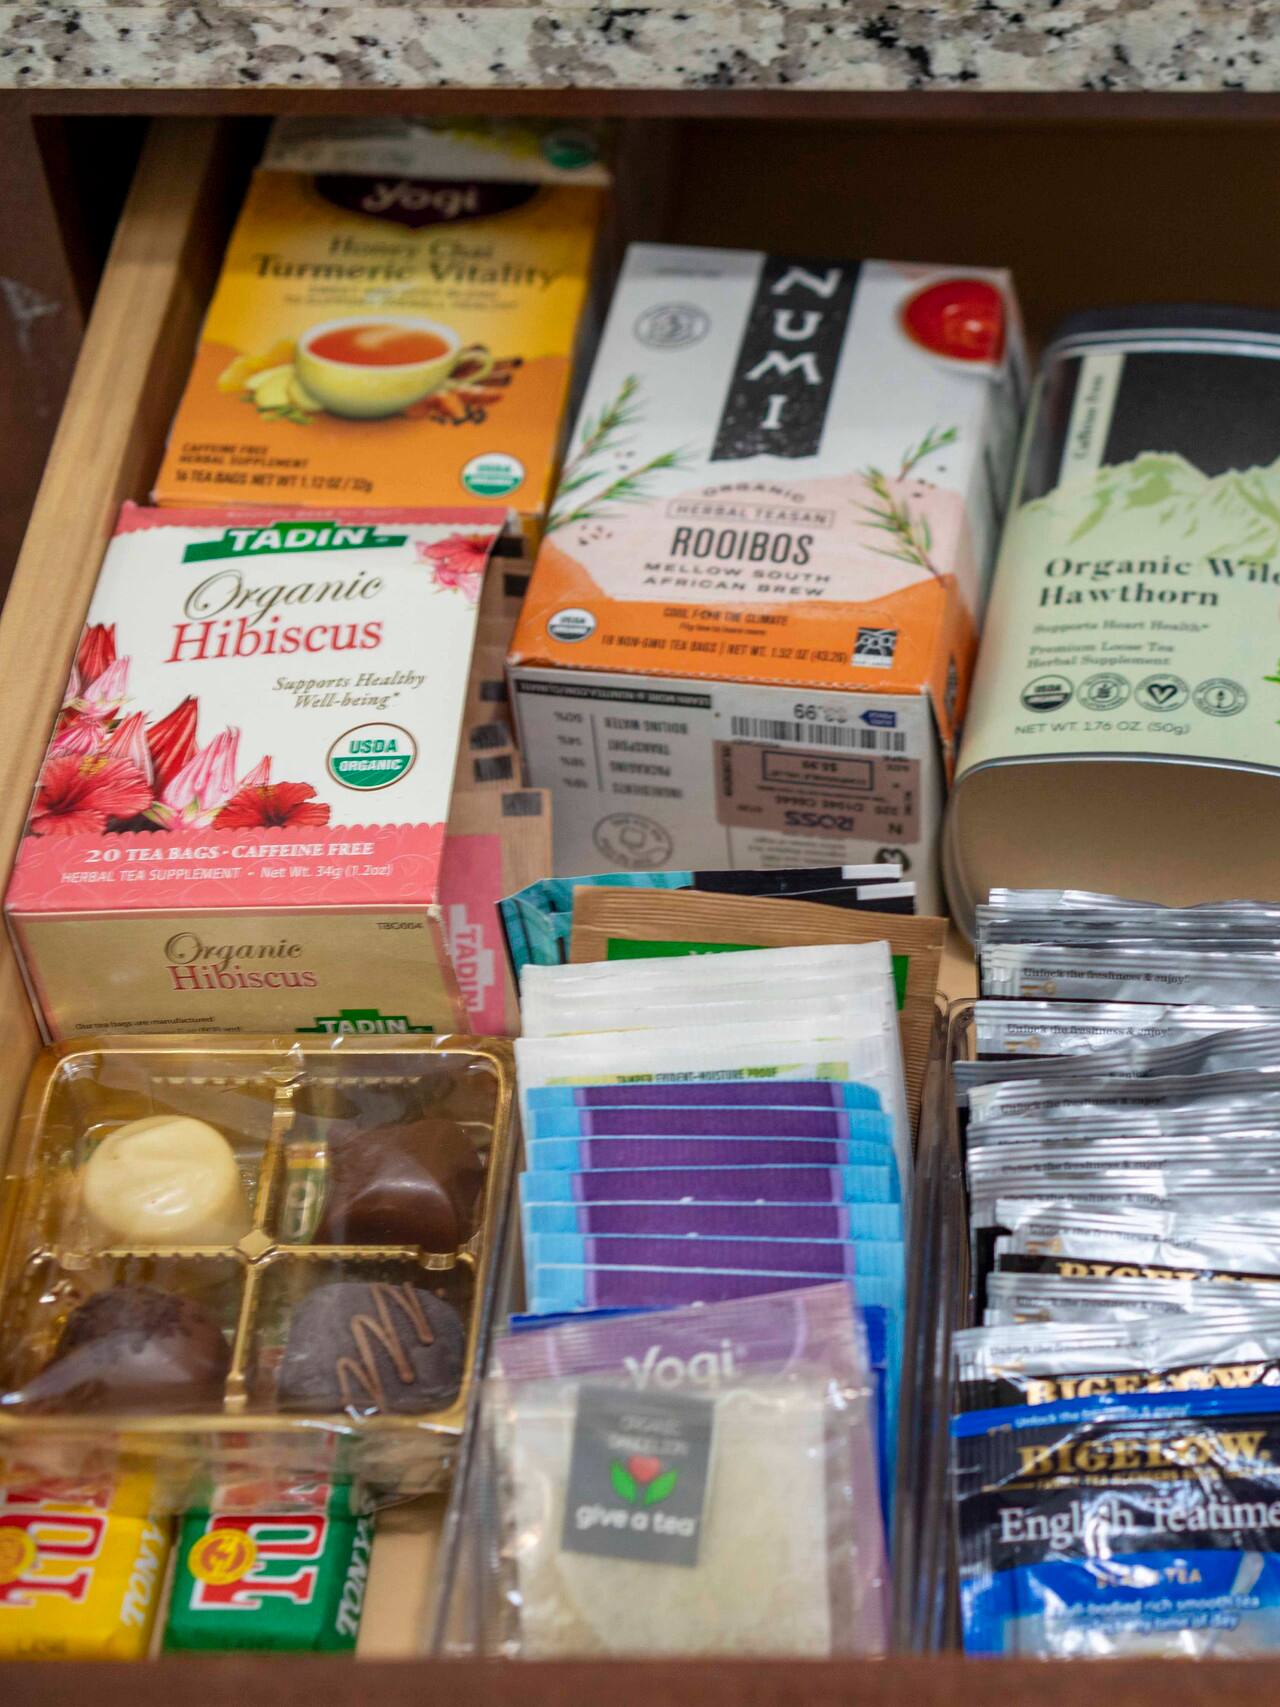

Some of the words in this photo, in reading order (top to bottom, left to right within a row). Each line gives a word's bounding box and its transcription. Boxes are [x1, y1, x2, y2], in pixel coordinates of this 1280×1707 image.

[254, 252, 410, 281] Turmeric
[429, 260, 559, 291] Vitality
[745, 264, 843, 431] NUMI
[703, 482, 806, 503] ORGANIC
[676, 504, 747, 519] HERBAL
[755, 509, 828, 525] TEASAN
[227, 528, 369, 552] TADIN
[670, 526, 814, 566] ROOIBOS
[644, 562, 743, 577] MELLOW
[752, 569, 832, 584] SOUTH
[1045, 555, 1192, 581] Organic
[184, 568, 386, 627] Organic
[642, 576, 746, 591] AFRICAN
[757, 583, 825, 597] BREW
[1039, 582, 1219, 607] Hawthorn
[163, 614, 385, 664] Hibiscus
[272, 675, 352, 693] Supports
[357, 669, 426, 690] Healthy
[1015, 722, 1047, 735] NET
[348, 738, 399, 755] USDA
[337, 757, 405, 773] ORGANIC
[785, 811, 855, 831] ROSS
[84, 849, 122, 863] 20
[125, 847, 164, 862] TEA
[167, 846, 221, 861] BAGS
[231, 844, 325, 858] CAFFEINE
[327, 842, 376, 857] FREE
[60, 871, 116, 884] HERBAL
[119, 869, 147, 882] TEA
[149, 867, 242, 881] SUPPLEMENT
[260, 867, 288, 878] Net
[316, 866, 344, 880] 34g
[164, 931, 303, 973] Organic
[166, 964, 318, 991] Hibiscus
[455, 928, 479, 1008] TADIN
[318, 1019, 408, 1035] TADIN
[575, 1503, 629, 1531] give
[630, 1508, 649, 1532] a
[653, 1511, 695, 1537] tea
